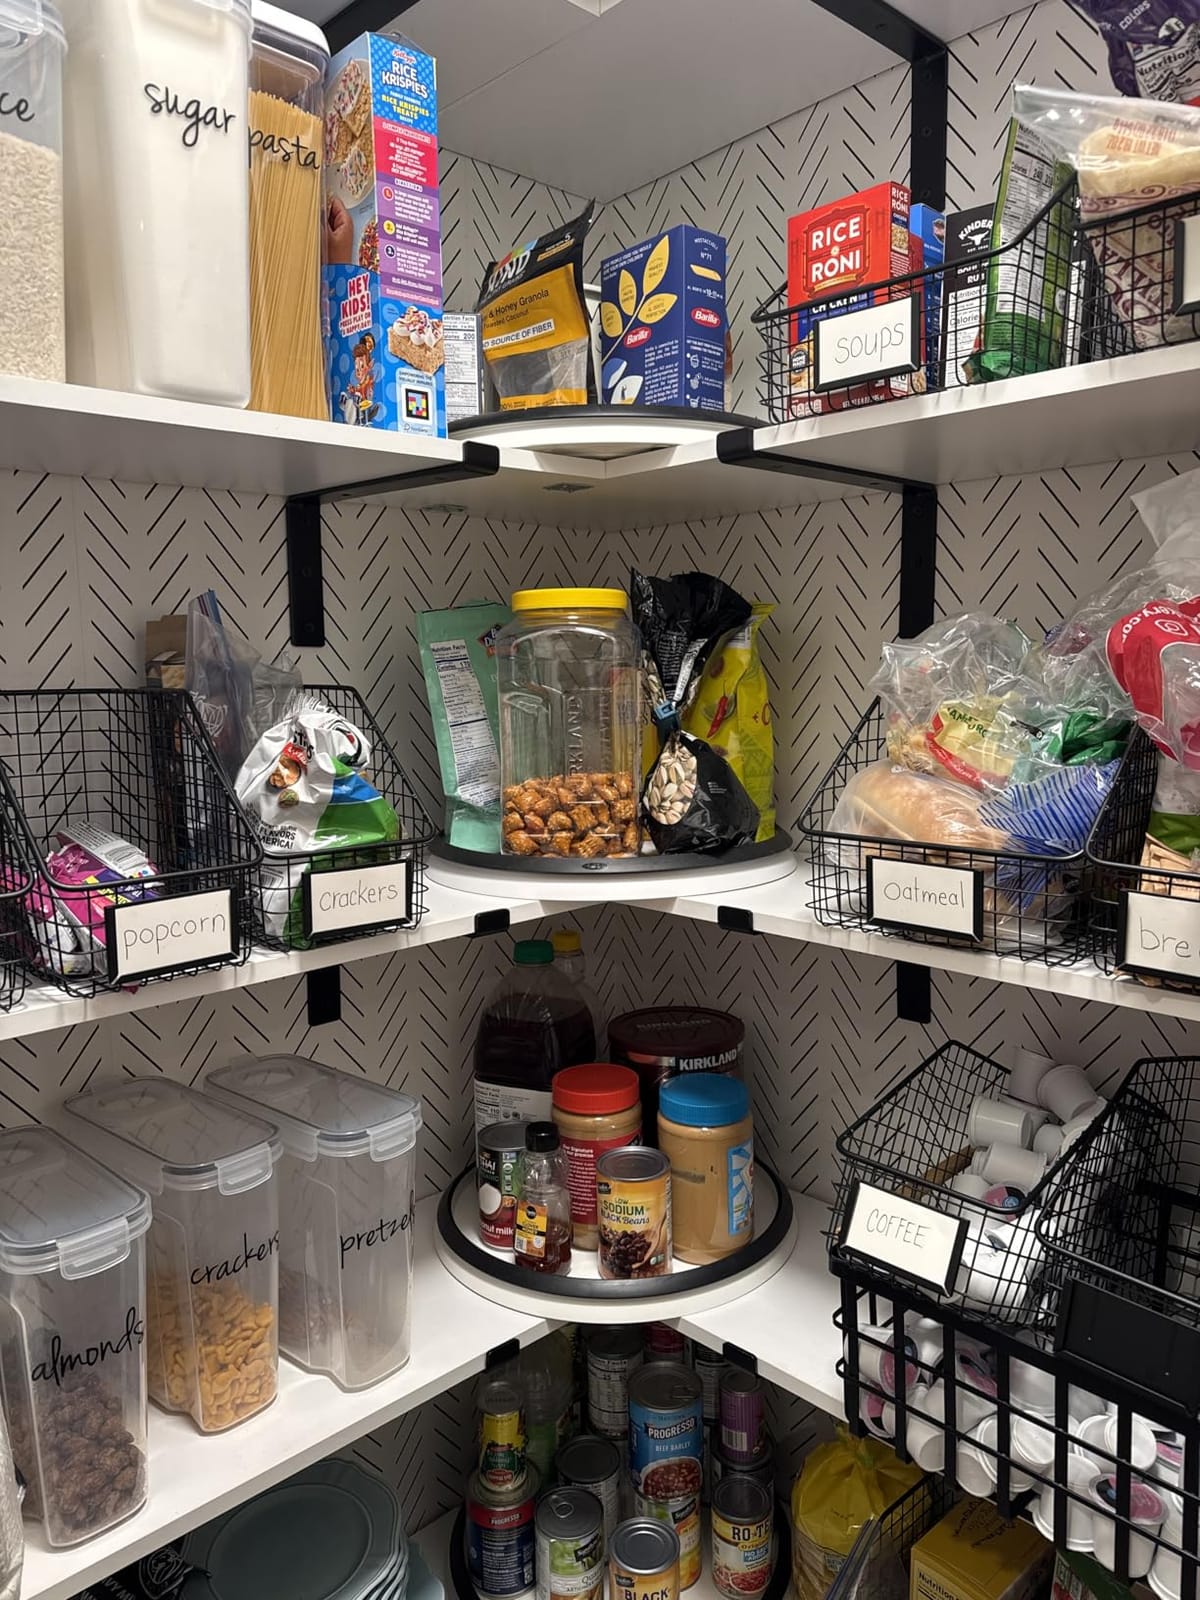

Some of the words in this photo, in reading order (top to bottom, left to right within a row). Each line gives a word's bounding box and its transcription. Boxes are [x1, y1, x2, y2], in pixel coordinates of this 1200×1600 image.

[1119, 0, 1151, 30] COLORS
[392, 61, 417, 81] RICE
[382, 71, 428, 99] KRISPIES
[143, 82, 236, 148] sugar
[393, 106, 418, 120] TREATS
[248, 124, 320, 171] pasta
[891, 186, 908, 203] RICE
[891, 199, 909, 215] RONI
[812, 217, 861, 251] RICE
[958, 219, 993, 241] KINDER
[811, 250, 861, 283] RONI
[348, 274, 369, 298] HEY
[341, 292, 370, 320] KIDS!
[495, 302, 518, 315] Honey
[519, 289, 549, 306] Granola
[695, 310, 719, 325] Barilla
[491, 333, 521, 346] SOURCE
[521, 329, 532, 338] OF
[532, 321, 553, 335] FIBER
[627, 330, 650, 345] Barilla
[258, 833, 294, 849] MERICA!
[122, 911, 226, 961] popcorn
[1140, 917, 1200, 958] bre
[680, 1048, 737, 1071] KIRKLAND
[603, 1199, 645, 1216] SODIUM
[340, 1189, 416, 1269] pretzel
[866, 1208, 931, 1248] COFFEE
[31, 1306, 144, 1387] almonds
[648, 1417, 696, 1440] PROGRESSO
[624, 1587, 668, 1600] BLACK
